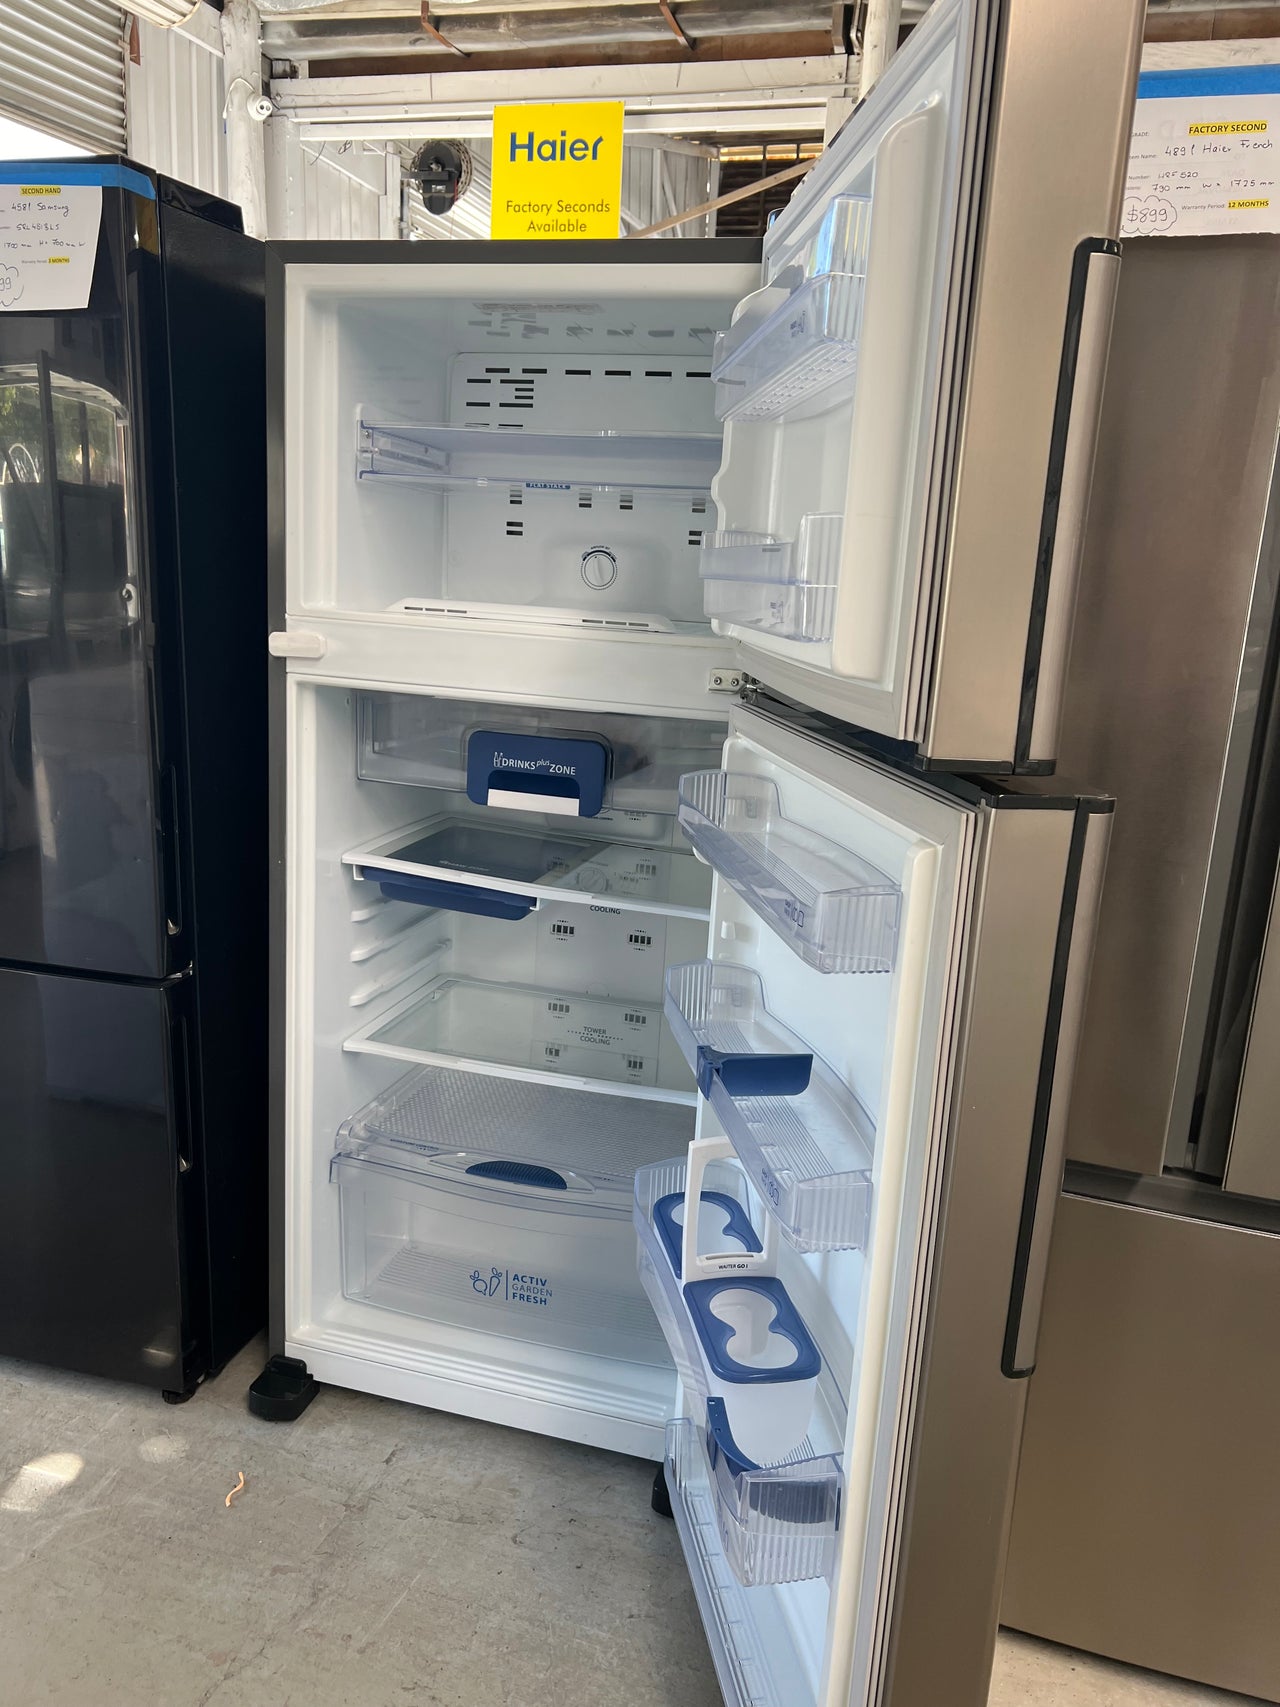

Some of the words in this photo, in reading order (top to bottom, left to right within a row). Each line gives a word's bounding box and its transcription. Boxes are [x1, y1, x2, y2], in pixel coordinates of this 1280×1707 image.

[1188, 125, 1229, 134] FACTORY
[1231, 123, 1267, 132] SECOND
[509, 130, 604, 162] Haier
[1203, 142, 1231, 154] Haier
[1240, 139, 1273, 149] French
[21, 187, 44, 195] SECOND
[37, 202, 70, 218] Samsung
[506, 200, 553, 216] Factory
[556, 199, 610, 213] Seconds
[1237, 200, 1269, 208] MONTHS
[1127, 204, 1168, 223] $899
[527, 218, 587, 232] Available
[502, 757, 536, 770] DRINKS
[536, 758, 550, 767] plus
[549, 764, 576, 776] ZONE
[589, 904, 621, 915] COOLING
[583, 1026, 607, 1035] TOWER
[580, 1035, 611, 1046] COOLING
[512, 1273, 547, 1287] ACTIV
[511, 1283, 553, 1297] GARDEN
[512, 1292, 547, 1306] FRESH
